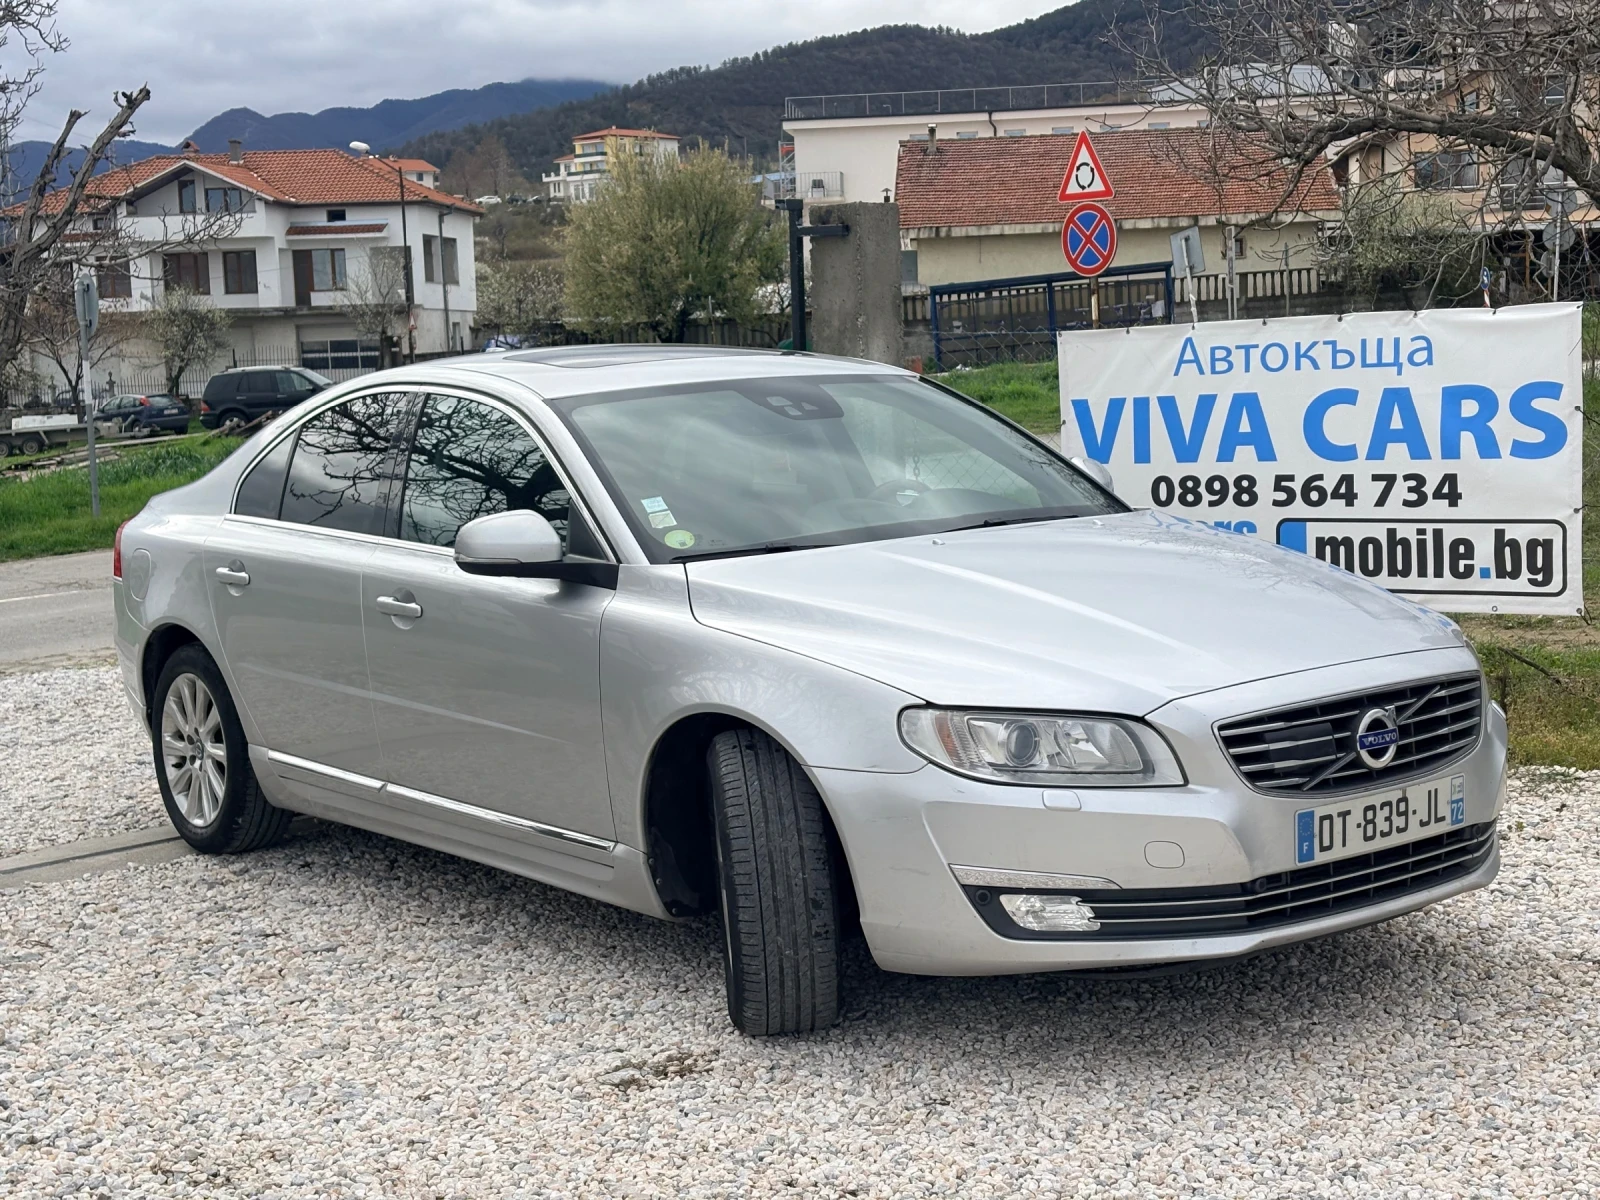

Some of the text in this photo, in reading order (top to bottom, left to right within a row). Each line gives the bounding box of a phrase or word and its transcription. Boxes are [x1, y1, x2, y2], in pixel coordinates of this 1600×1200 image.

[1173, 335, 1434, 377] Автокъща
[1071, 381, 1568, 464] VIVA CARS
[1151, 472, 1463, 508] 0898 564 734
[1315, 526, 1554, 588] mobile.bg
[1361, 732, 1397, 746] VOLVO
[1303, 842, 1309, 854] F
[1451, 802, 1464, 821] 72
